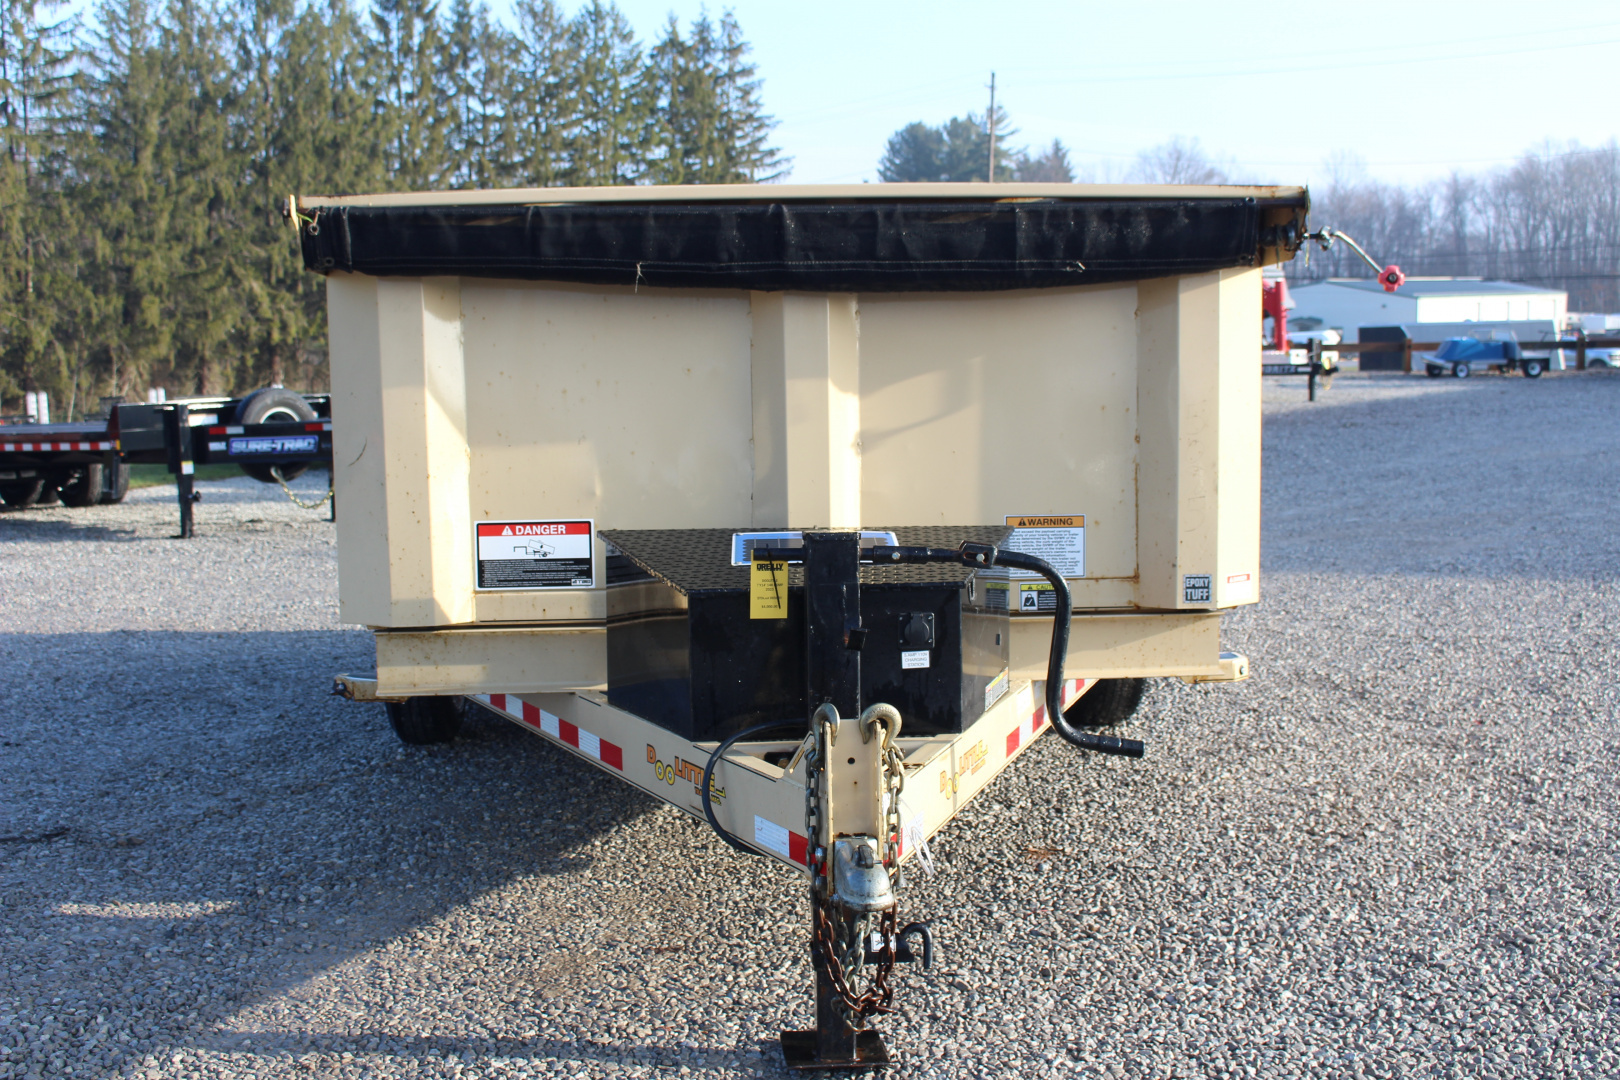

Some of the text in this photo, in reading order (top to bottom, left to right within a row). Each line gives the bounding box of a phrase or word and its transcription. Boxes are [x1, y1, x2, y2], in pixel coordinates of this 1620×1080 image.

[231, 439, 316, 453] SURE-TRAC
[1027, 517, 1073, 526] WARNING
[515, 525, 566, 535] DANGER
[1186, 578, 1209, 587] EPOXY
[1186, 588, 1209, 600] TUFF
